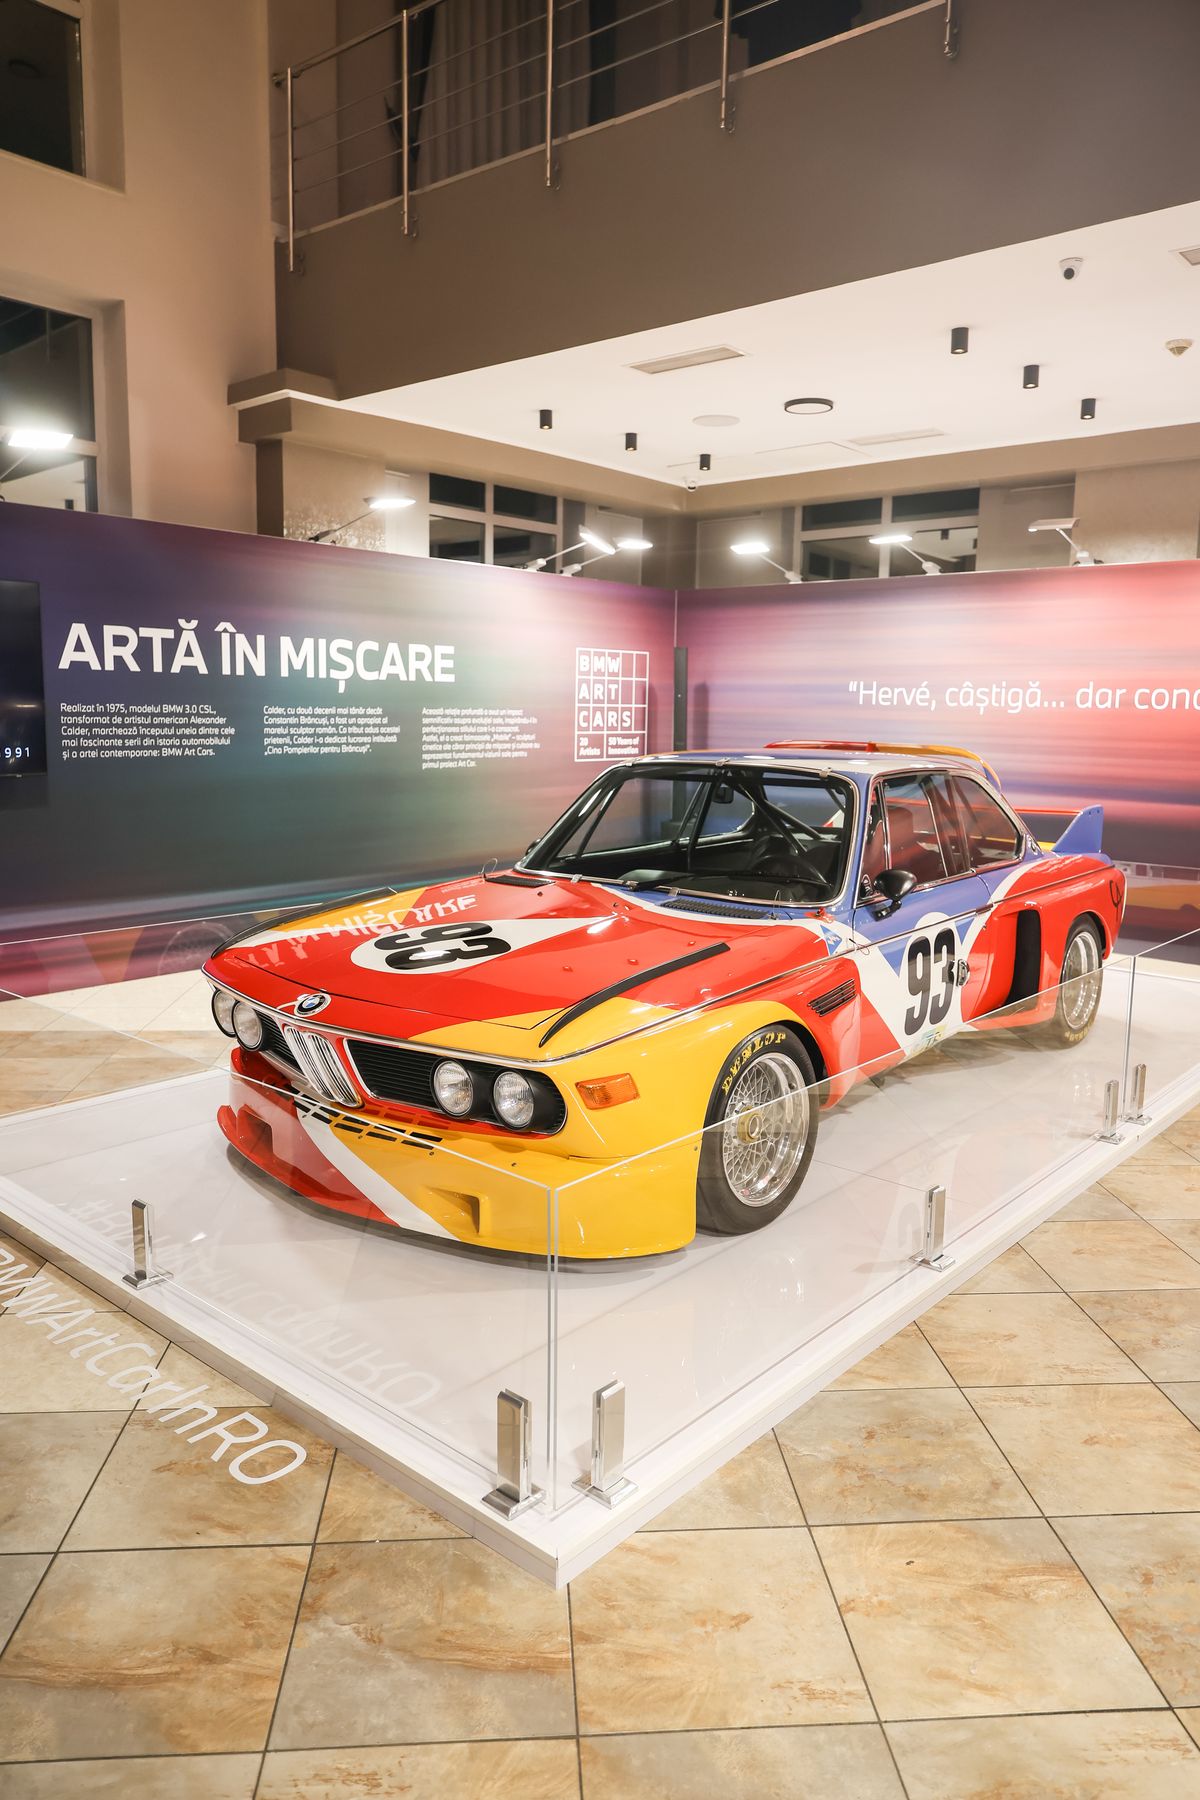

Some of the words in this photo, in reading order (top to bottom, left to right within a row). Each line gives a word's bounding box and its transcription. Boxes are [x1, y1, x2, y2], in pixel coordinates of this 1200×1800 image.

[58, 619, 208, 674] ARTĂ
[215, 622, 266, 677] ÎN
[280, 636, 455, 693] MIȘCARE
[580, 655, 620, 673] BMW
[579, 683, 618, 700] ART
[945, 681, 1064, 715] câștigă...
[1076, 681, 1126, 708] dar
[60, 703, 95, 713] Realizat
[96, 704, 104, 712] în
[106, 704, 127, 714] 1975,
[129, 704, 160, 713] modelul
[163, 705, 183, 713] BMW
[185, 705, 196, 713] 3.0
[199, 705, 216, 715] CSL,
[61, 715, 110, 724] transformat
[112, 716, 122, 724] de
[124, 715, 151, 724] artistul
[190, 716, 226, 724] Alexander
[579, 711, 631, 727] CARS
[62, 726, 90, 736] Calder,
[139, 726, 174, 737] începutul
[176, 726, 197, 735] uneia
[198, 726, 219, 735] dintre
[220, 727, 235, 735] cele
[62, 738, 78, 747] mai
[80, 737, 122, 746] fascinante
[125, 737, 141, 746] serii
[143, 737, 155, 745] din
[157, 737, 180, 745] istoria
[0, 747, 30, 758] 991
[80, 749, 98, 757] artei
[162, 748, 182, 756] BMW
[184, 747, 195, 756] Art
[197, 747, 215, 756] Cars.
[374, 922, 511, 970] 93
[904, 927, 955, 1036] 93
